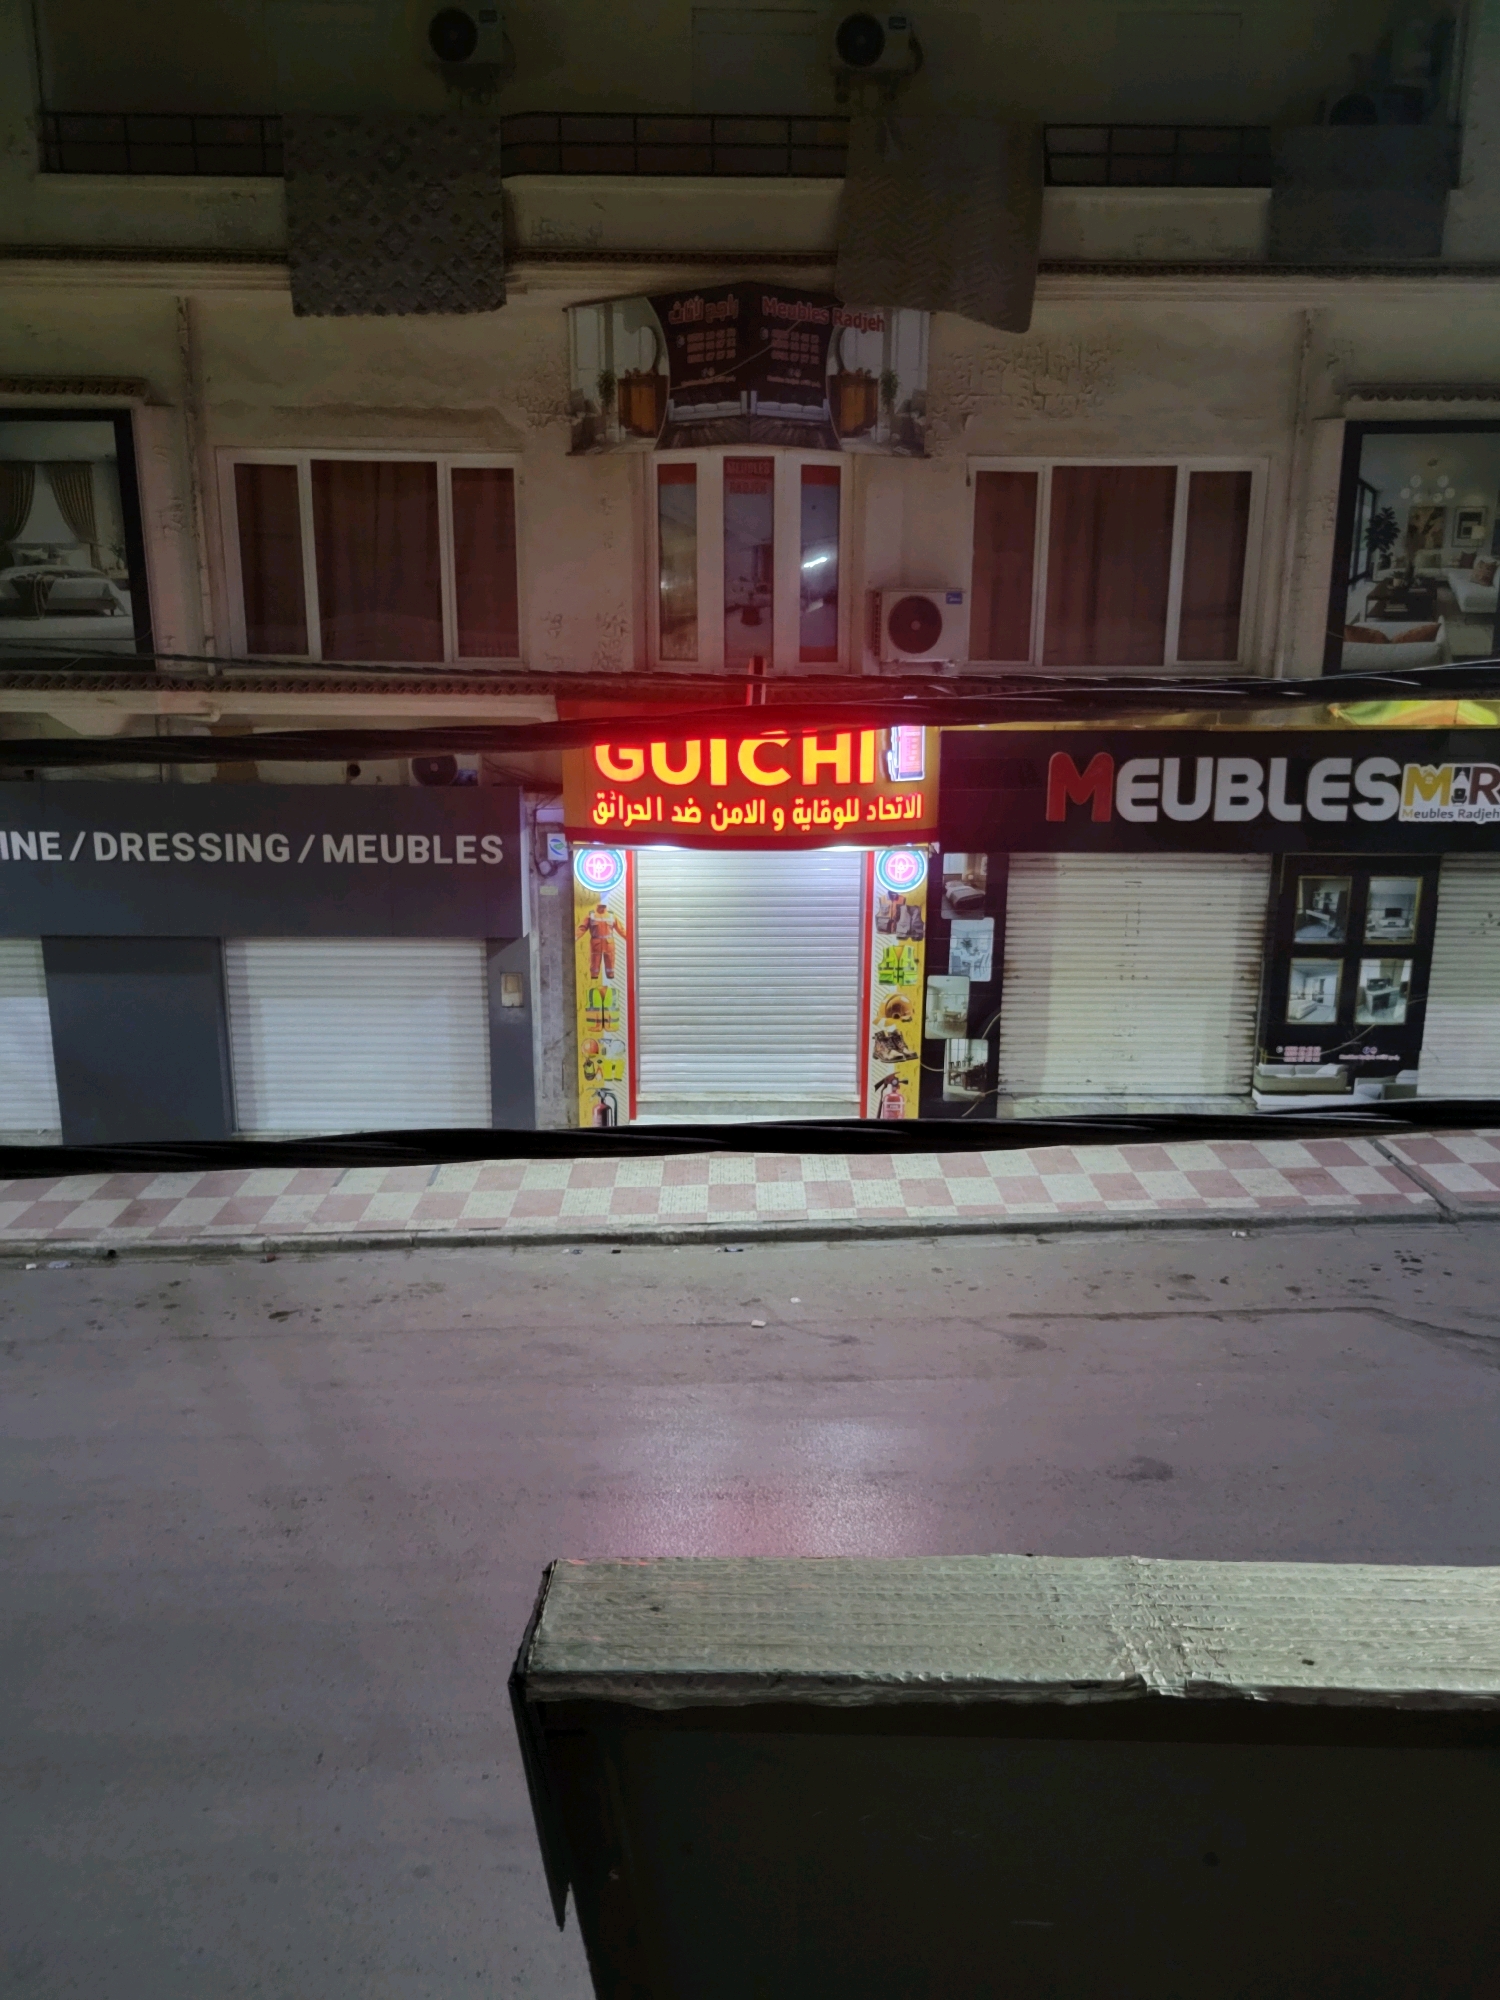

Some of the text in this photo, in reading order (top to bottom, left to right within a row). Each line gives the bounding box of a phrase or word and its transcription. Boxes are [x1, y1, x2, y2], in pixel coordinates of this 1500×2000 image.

[761, 296, 885, 334] Meubles Radjeh
[594, 730, 876, 787] GUICHI
[1046, 751, 1401, 823] MEUBLES
[592, 790, 924, 832] الاتحاد للوقاية و الامن ضد الحرائق
[1402, 808, 1500, 821] Meubles Radjeh
[94, 832, 291, 863] DRESSING
[323, 834, 504, 865] MEUBLES
